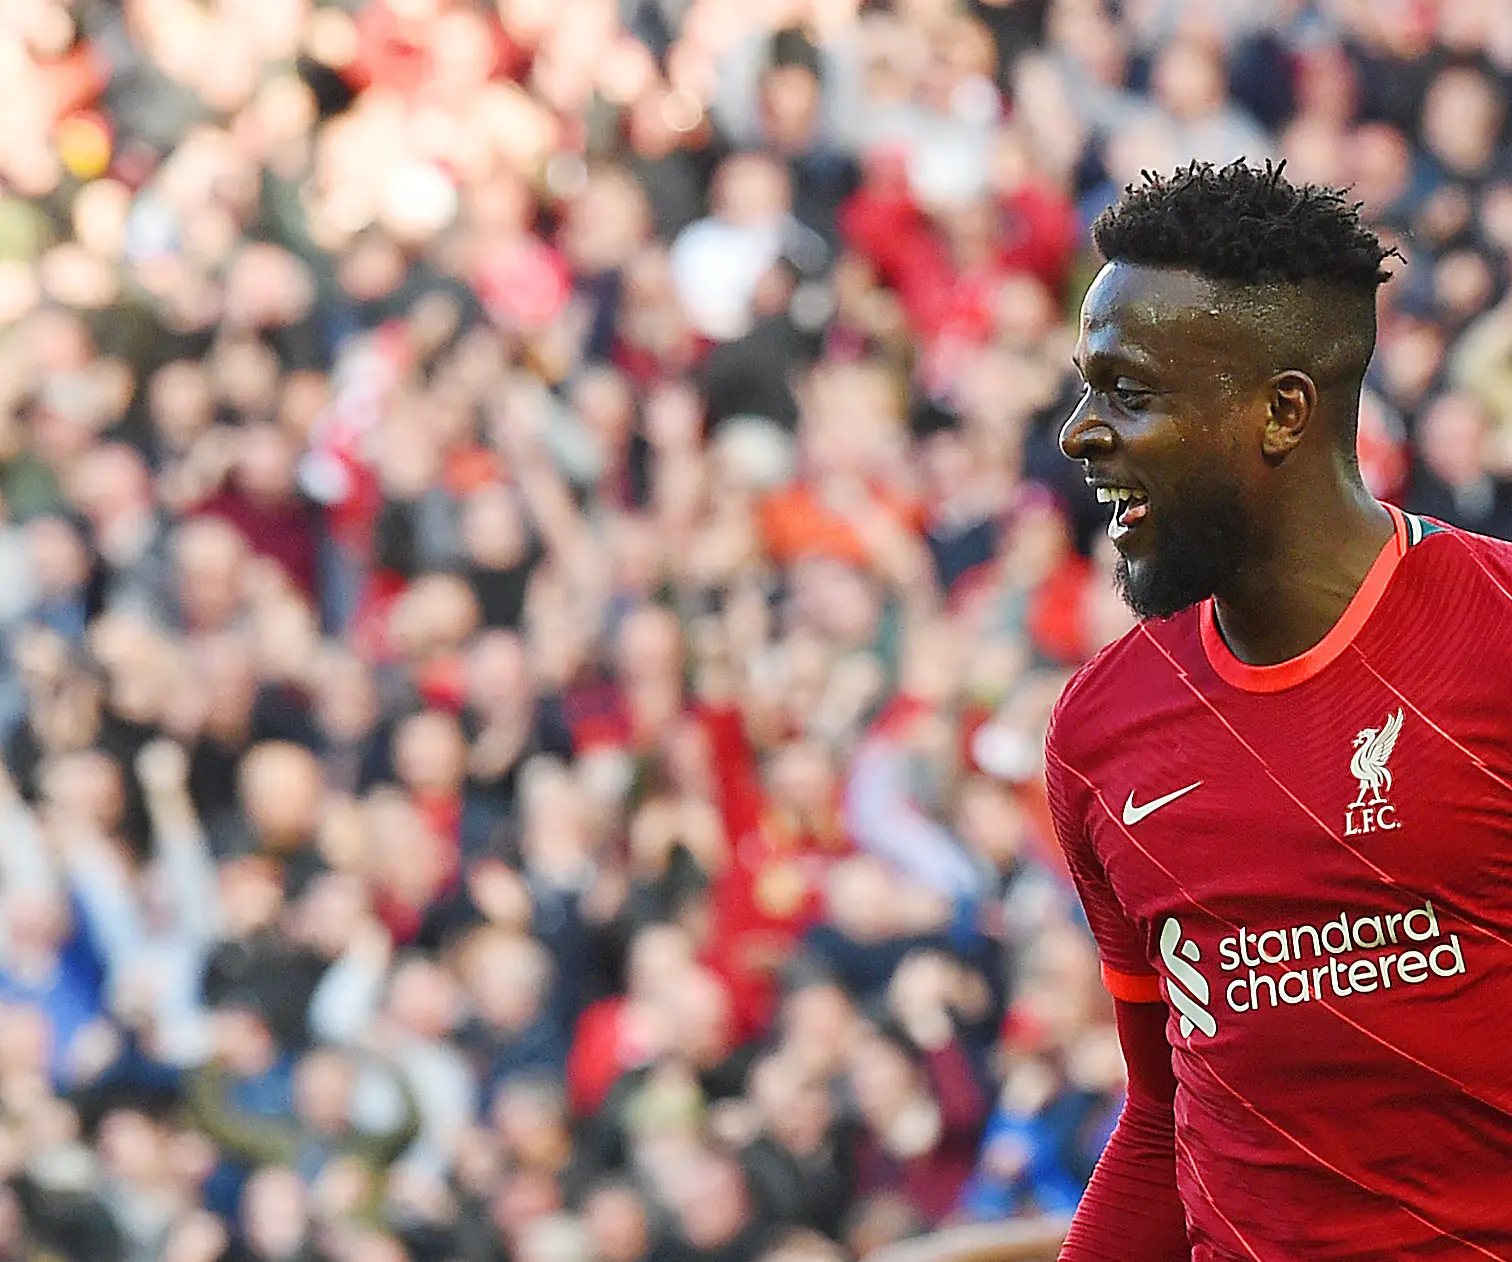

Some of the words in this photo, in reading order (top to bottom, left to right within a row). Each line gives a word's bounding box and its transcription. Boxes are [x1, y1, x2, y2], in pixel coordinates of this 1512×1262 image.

[1344, 805, 1402, 836] L.F.C.
[1219, 899, 1440, 970] standard
[1226, 934, 1466, 1012] chartered
